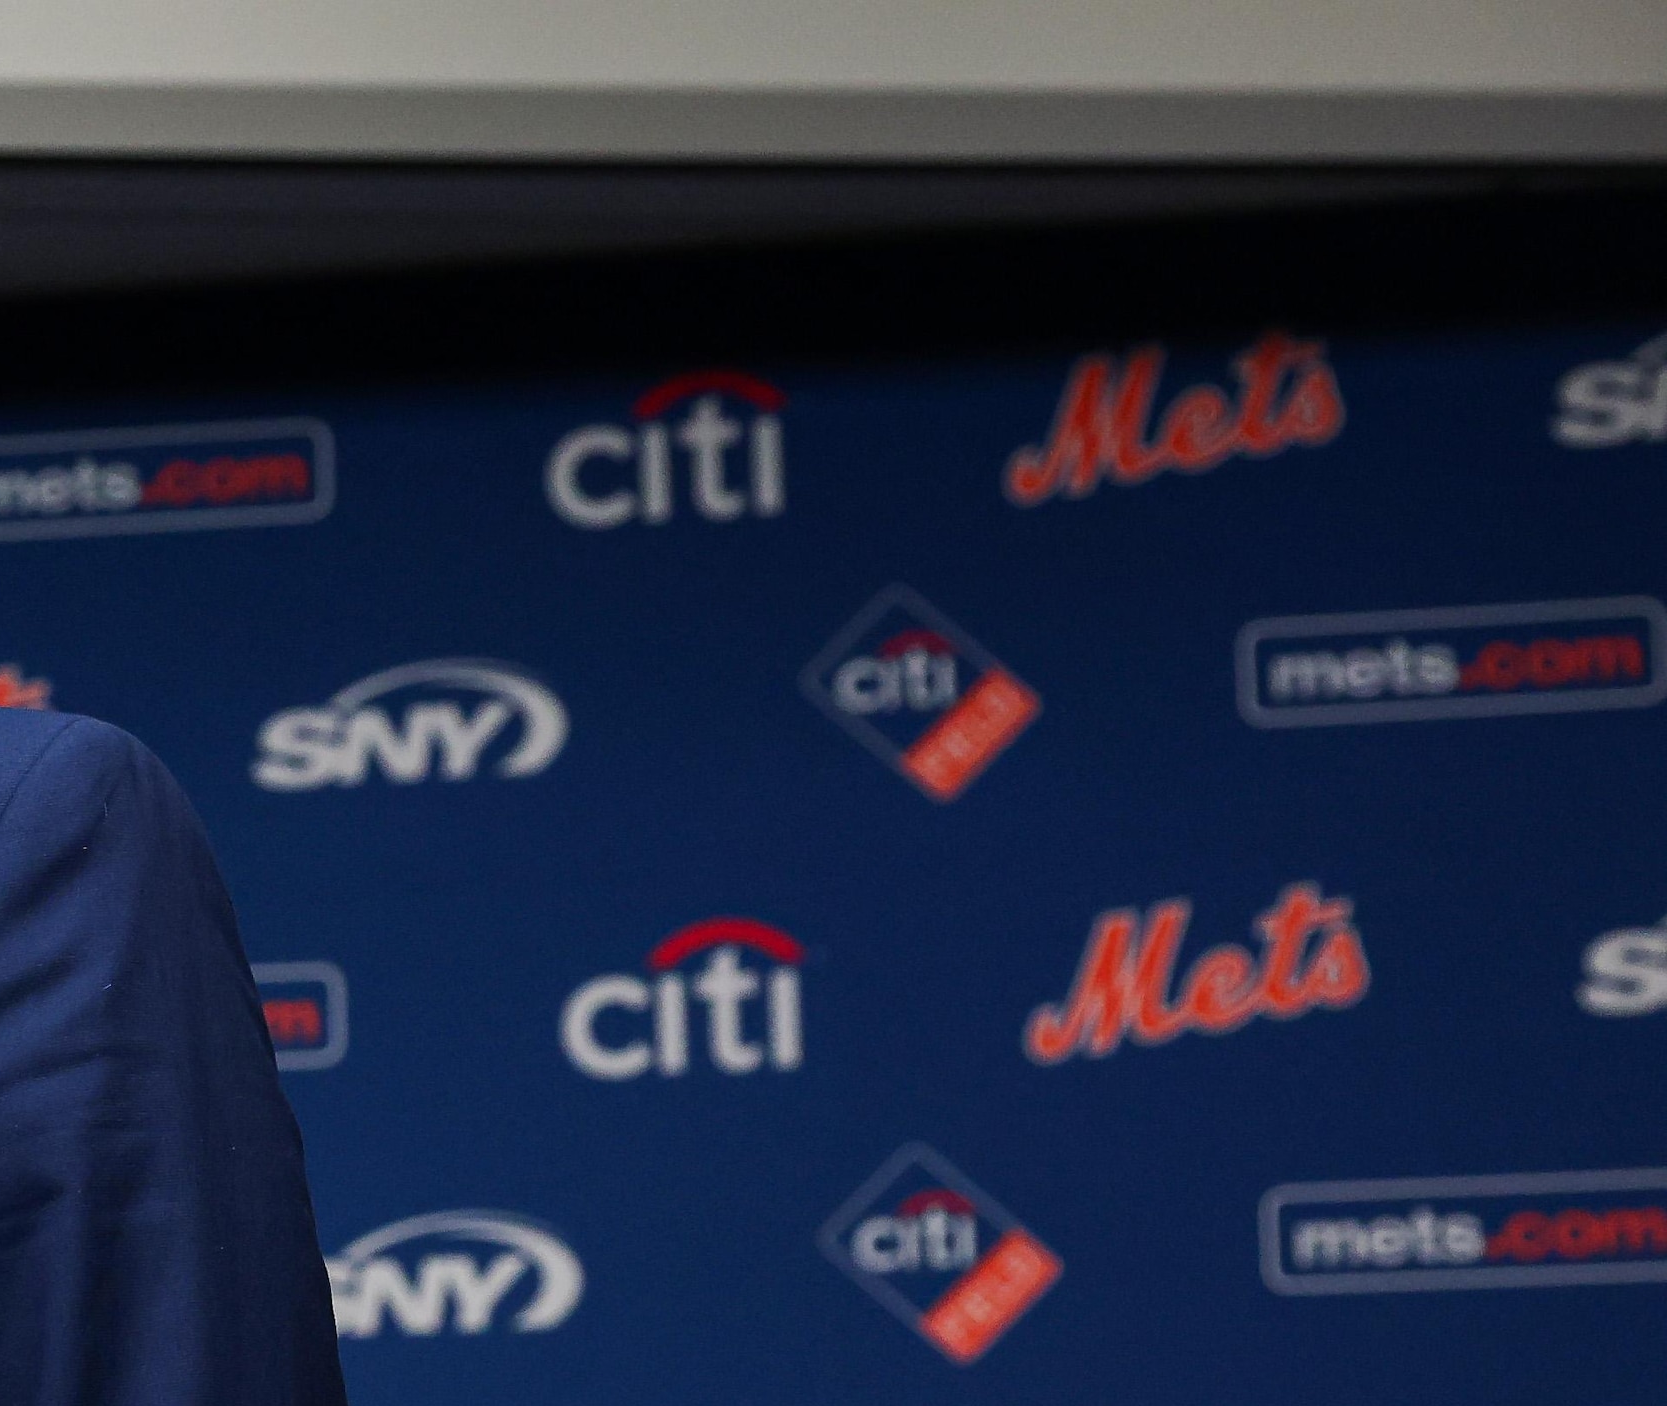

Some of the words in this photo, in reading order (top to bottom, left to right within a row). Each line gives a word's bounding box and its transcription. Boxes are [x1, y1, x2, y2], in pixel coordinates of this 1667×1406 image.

[543, 396, 787, 530] citi
[1004, 335, 1346, 506] Mets
[250, 698, 515, 791] SNY
[830, 646, 958, 715] citi
[557, 944, 805, 1082] citi
[1023, 882, 1371, 1065] Mets
[850, 1202, 978, 1276] citi
